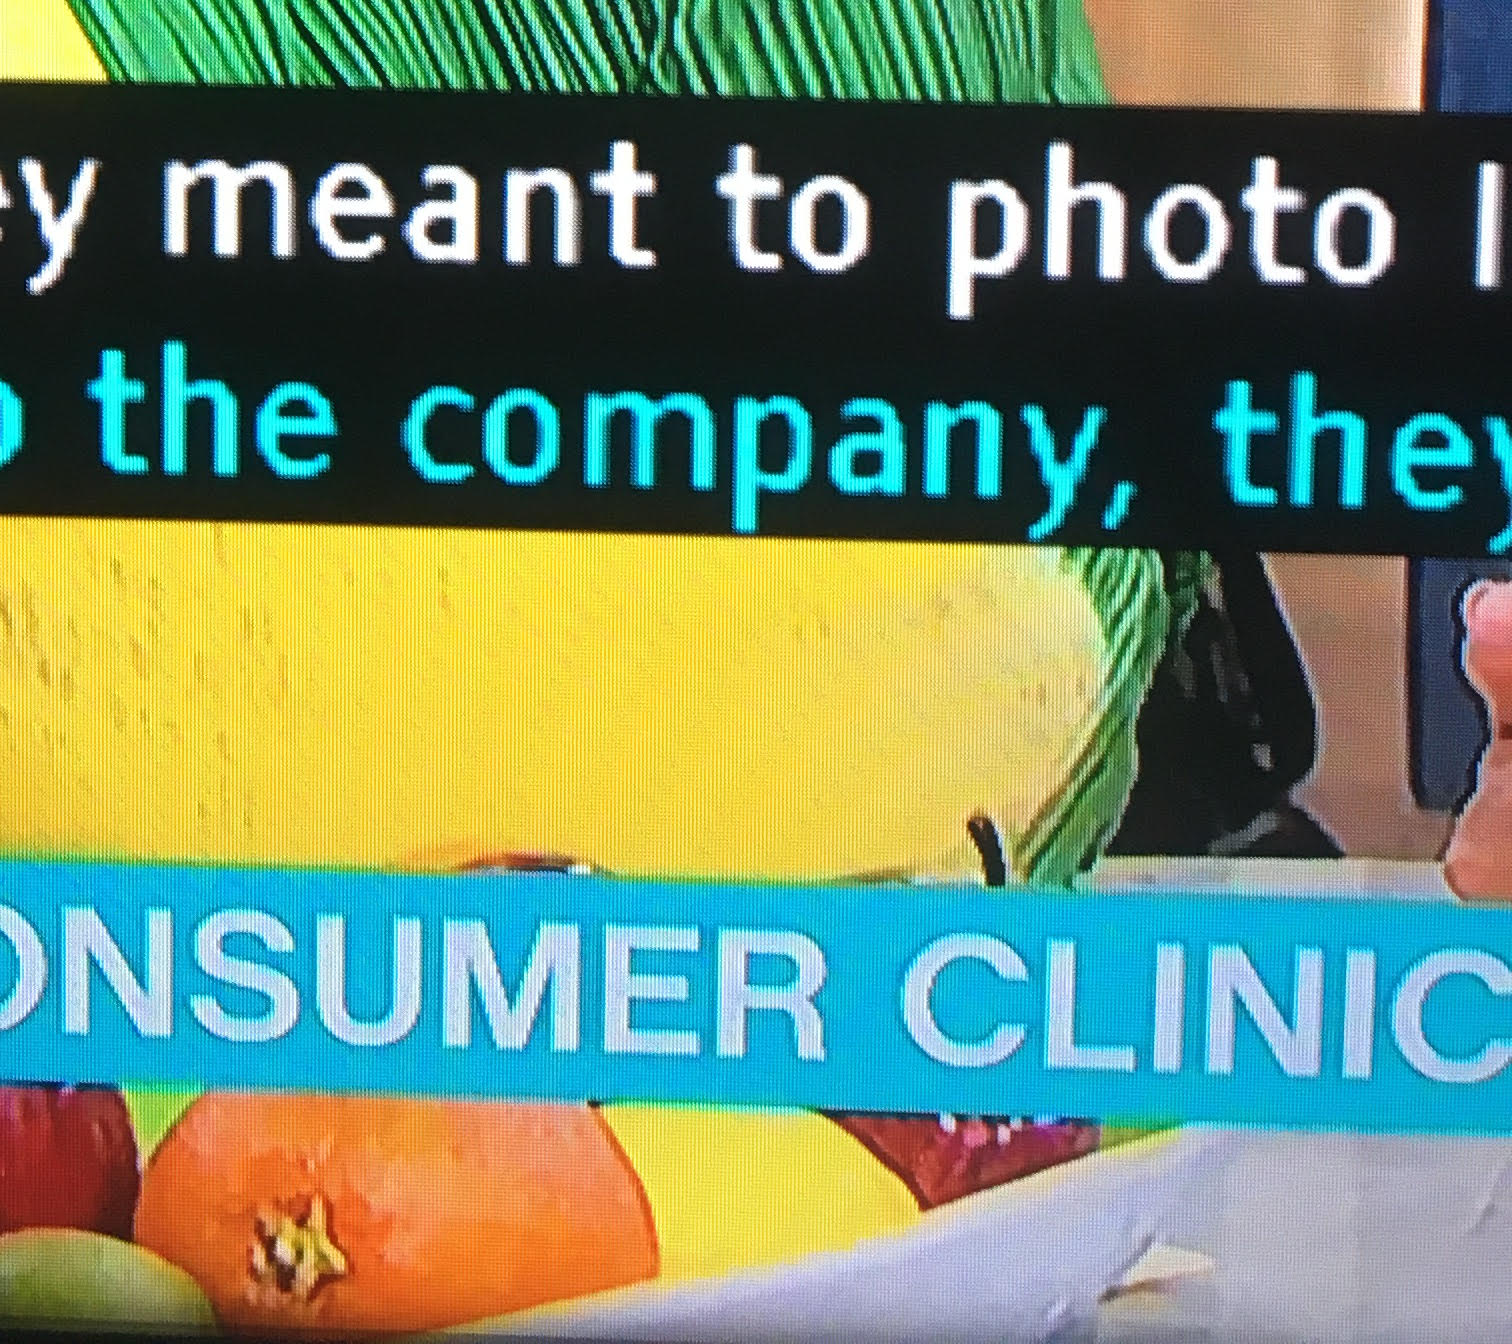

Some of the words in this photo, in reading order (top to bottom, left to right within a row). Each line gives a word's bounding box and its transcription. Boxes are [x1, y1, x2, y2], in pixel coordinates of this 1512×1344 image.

[163, 139, 658, 270] meant
[714, 141, 871, 275] to
[946, 139, 1397, 321] photo
[85, 338, 339, 481] the
[400, 383, 1138, 542] company,
[899, 932, 1512, 1085] CLINIC
